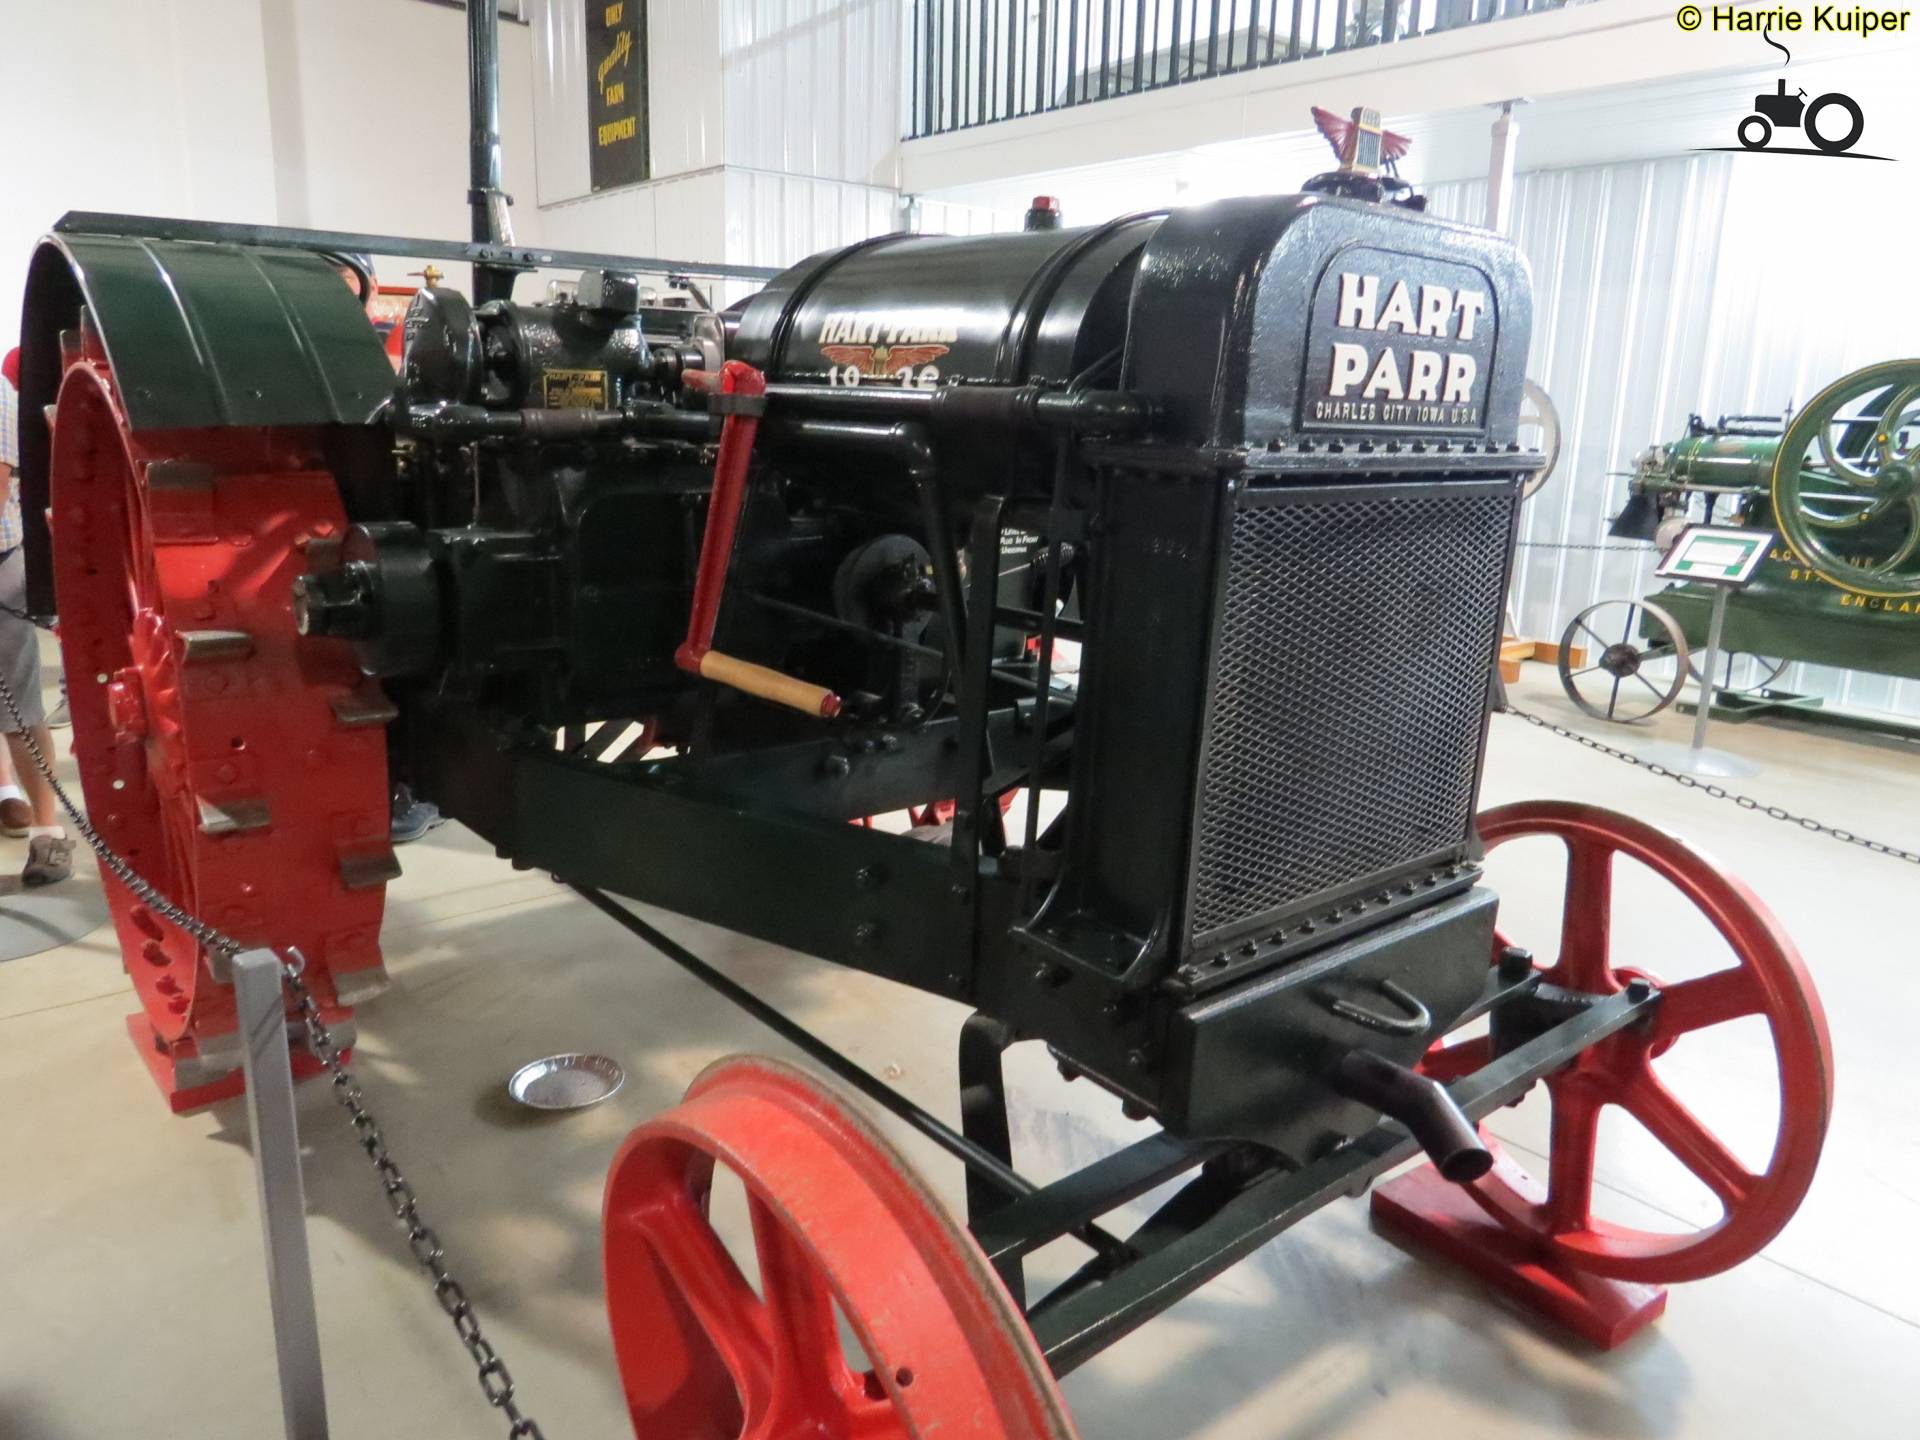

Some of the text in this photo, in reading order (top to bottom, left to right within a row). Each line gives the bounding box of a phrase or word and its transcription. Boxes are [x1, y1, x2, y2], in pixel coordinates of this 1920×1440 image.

[605, 82, 625, 107] FARM
[598, 116, 637, 146] EQUIPMENT
[1337, 271, 1485, 341] HART
[1329, 342, 1477, 403] PARR
[1316, 401, 1377, 420] CHARLES
[1383, 404, 1412, 421] CITY
[1417, 405, 1445, 423] IOWA
